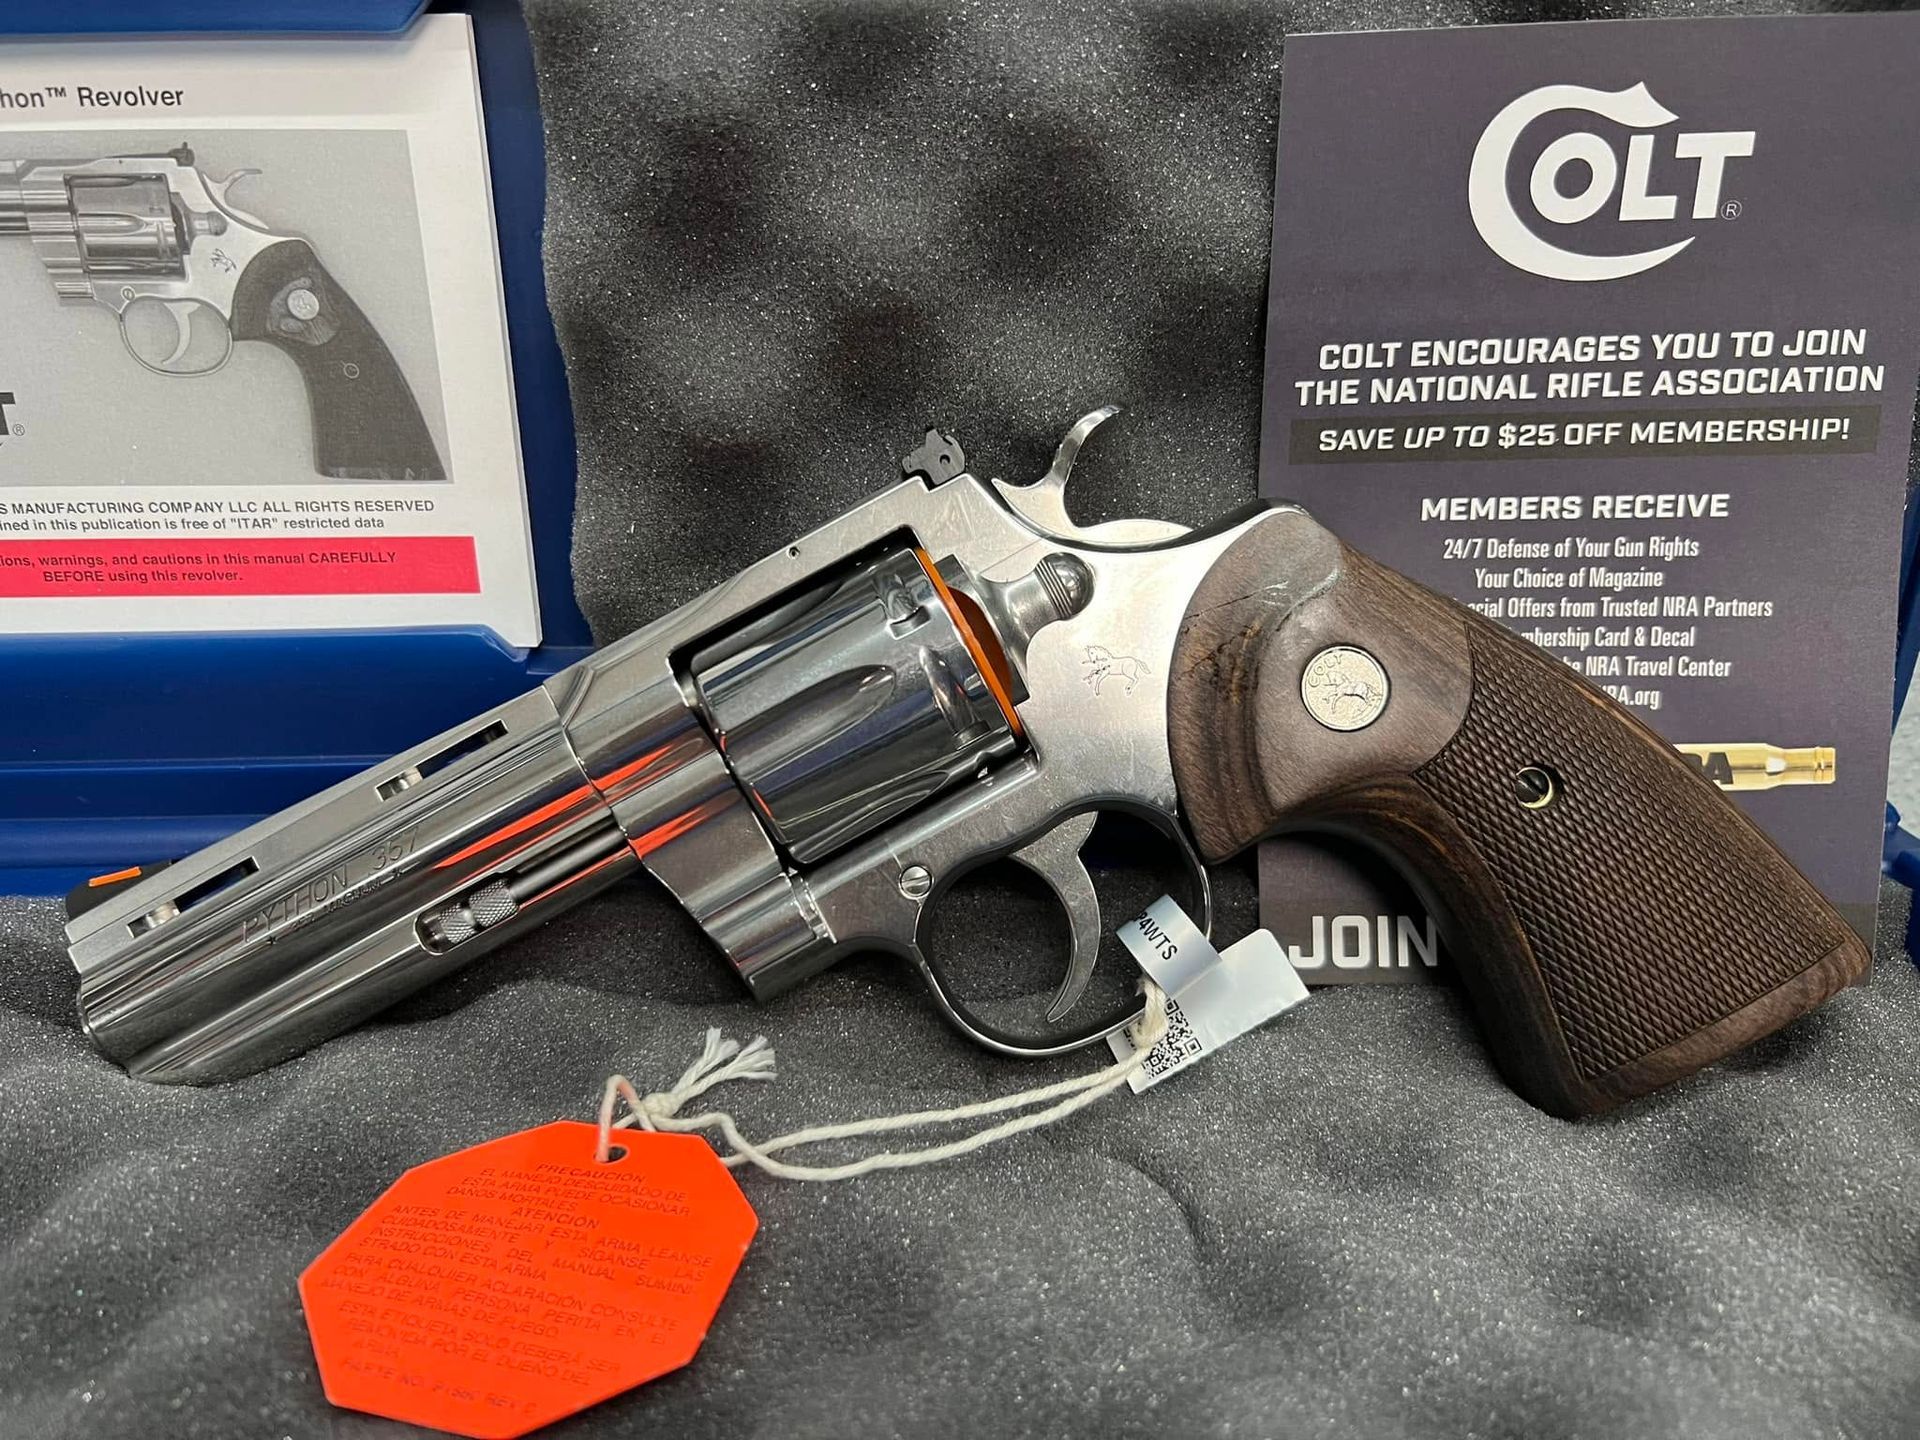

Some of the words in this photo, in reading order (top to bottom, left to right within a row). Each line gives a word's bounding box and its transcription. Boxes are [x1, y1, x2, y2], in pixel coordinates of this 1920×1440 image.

[77, 86, 184, 107] Revolver
[1319, 342, 1402, 370] COLT
[1410, 335, 1641, 367] ENCOURAGES
[1651, 332, 1720, 359] YOU
[1730, 331, 1774, 357] TO
[1782, 328, 1866, 357] JOIN
[1295, 379, 1360, 406] THE
[1370, 373, 1538, 403] NATIONAL
[1547, 371, 1643, 399] RIFLE
[1650, 365, 1885, 396] ASSOCIATION
[1319, 428, 1394, 451] SAVE
[1404, 427, 1445, 449] UP
[1453, 425, 1489, 447] TO
[1498, 422, 1556, 449] $25
[1564, 422, 1622, 445] OFF
[1630, 418, 1850, 444] MEMBERSHIP!
[12, 502, 143, 514] MANUFACTURING
[149, 501, 223, 513] COMPANY
[229, 501, 257, 512] LLC
[263, 501, 291, 512] ALL
[295, 501, 350, 512] RIGHTS
[355, 500, 434, 511] RESERVED
[1421, 496, 1582, 521] MEMBERS
[1592, 494, 1730, 519] RECEIVE
[33, 519, 47, 530] in
[51, 518, 77, 530] this
[82, 518, 160, 533] publication
[165, 518, 177, 529] is
[181, 517, 208, 529] free
[213, 516, 226, 529] of
[231, 517, 278, 528] "ITAR"
[284, 516, 350, 528] restricted
[355, 516, 384, 528] data
[39, 554, 107, 568] warnings,
[112, 553, 137, 565] and
[143, 553, 202, 565] cautions
[207, 553, 220, 564] in
[224, 552, 249, 564] this
[254, 552, 303, 564] manual
[309, 552, 396, 563] CAREFULLY
[1443, 538, 1484, 559] 24/7
[1487, 537, 1550, 558] Defense
[1555, 537, 1571, 558] of
[1576, 537, 1610, 558] Your
[1614, 536, 1644, 557] Gun
[1649, 536, 1699, 561] Rights
[43, 570, 104, 582] BEFORE
[109, 569, 148, 583] using
[152, 568, 178, 581] this
[183, 568, 243, 581] revolver.
[1475, 568, 1509, 588] Your
[1513, 567, 1564, 588] Choice
[1569, 567, 1586, 587] of
[1589, 566, 1663, 591] Magazine
[1508, 597, 1555, 617] Offers
[1560, 597, 1594, 617] from
[1601, 596, 1658, 617] Trusted
[1662, 596, 1698, 616] NRA
[1704, 596, 1773, 616] Partners
[1594, 626, 1630, 647] Card
[1634, 627, 1646, 647] &
[1651, 626, 1695, 647] Decal
[1585, 656, 1620, 676] NRA
[1625, 655, 1673, 676] Travel
[1677, 656, 1732, 677] Center
[242, 863, 348, 943] PYTHON
[371, 826, 421, 870] 357
[1288, 915, 1438, 968] JOIN
[461, 1176, 497, 1188] ESTA
[499, 1181, 541, 1194] ARMA
[544, 1186, 599, 1201] PUEDE
[599, 1193, 691, 1217] OCASIONAR
[480, 1168, 496, 1177] EL
[501, 1170, 561, 1186] MANEJO
[563, 1178, 663, 1199] DESCUIDADO
[665, 1190, 687, 1203] DE
[498, 1192, 579, 1212] MORTALES
[393, 1205, 440, 1218] ANTES
[444, 1210, 468, 1221] DE
[471, 1213, 545, 1234] MANEJAR
[550, 1227, 588, 1243] ESTA
[597, 1236, 641, 1254] ARMA
[359, 1236, 421, 1254] STRADO
[423, 1245, 455, 1260] CON
[459, 1252, 498, 1270] ESTA
[500, 1260, 548, 1282] ARMA
[370, 1226, 493, 1253] INSTRUCCIONES
[506, 1248, 534, 1263] DEL
[551, 1257, 616, 1281] MANUAL
[381, 1215, 521, 1244] CUIDADOSAMENTE
[544, 1240, 554, 1250] Y
[674, 1267, 705, 1283] LAS
[333, 1265, 368, 1278] CON
[376, 1270, 441, 1292] ALGUNA
[452, 1286, 532, 1315] PERSONA
[543, 1308, 601, 1332] PERITA
[615, 1325, 638, 1339] EN
[346, 1252, 383, 1267] PARA
[387, 1258, 479, 1284] CUALQUIER
[590, 1302, 680, 1332] CONSULTE
[380, 1308, 457, 1334] ETIQUETA
[386, 1288, 412, 1302] DE
[411, 1293, 472, 1320] ARMAS
[472, 1309, 498, 1324] DE
[500, 1316, 560, 1339] FUEGO
[430, 1337, 469, 1357] POR
[471, 1349, 490, 1363] EL
